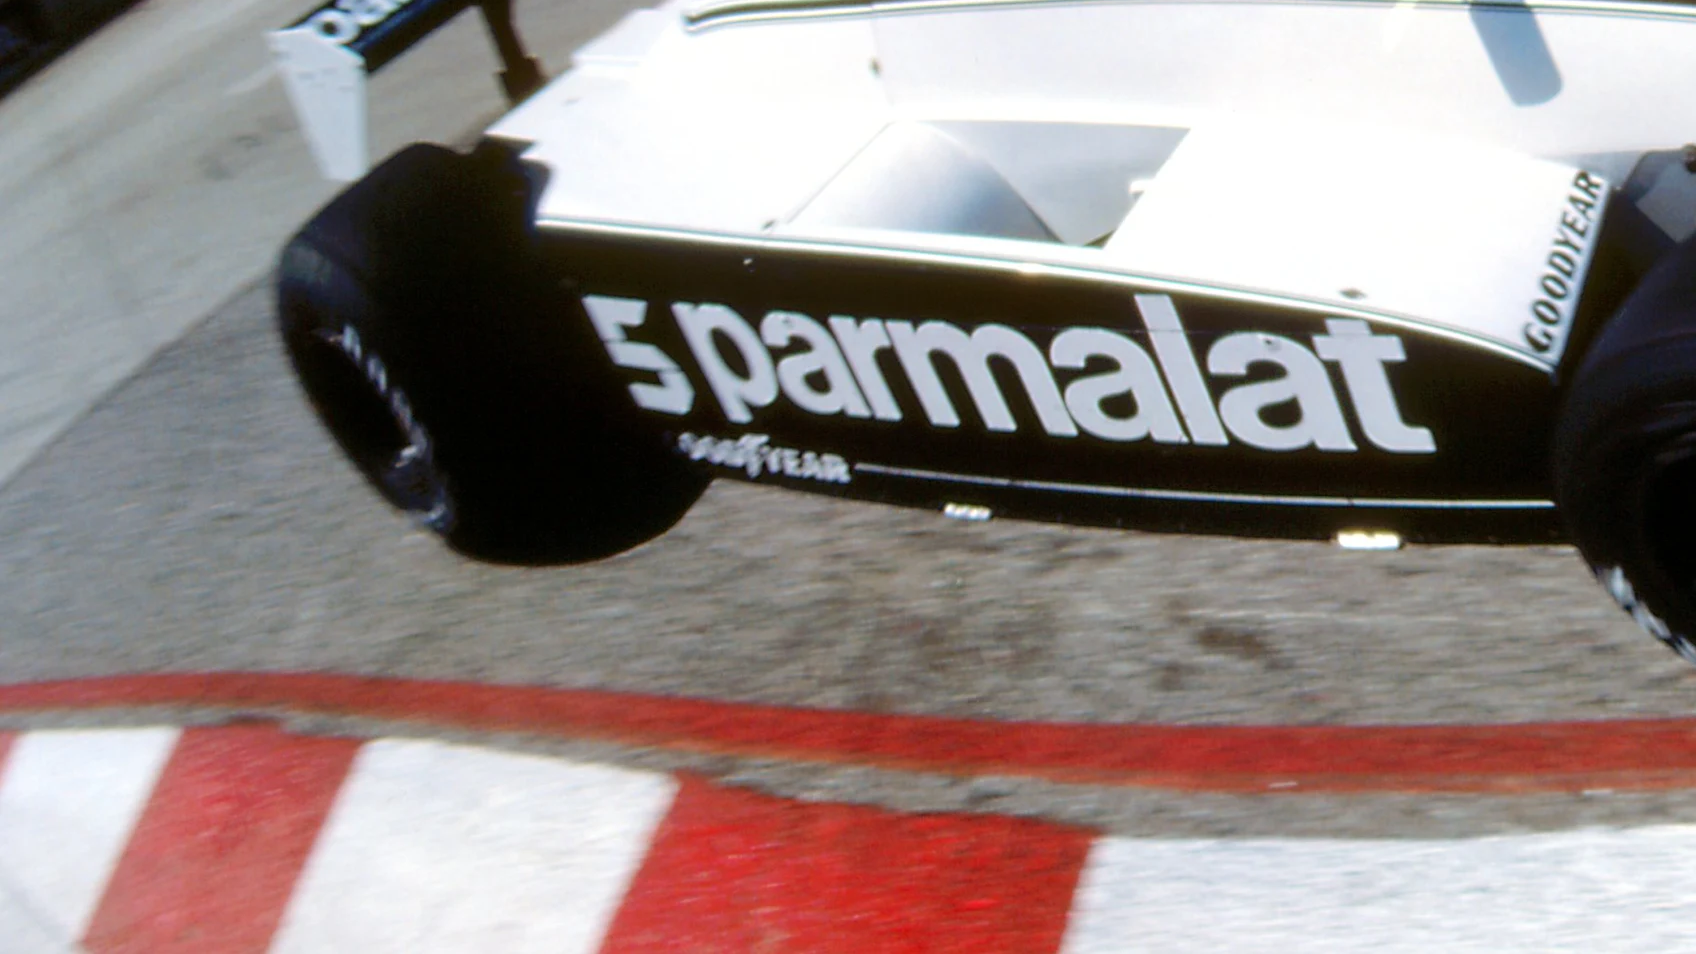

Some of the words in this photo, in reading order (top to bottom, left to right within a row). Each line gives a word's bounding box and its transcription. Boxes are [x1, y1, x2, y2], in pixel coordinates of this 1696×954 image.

[1522, 169, 1603, 354] GOODYEAR
[581, 294, 695, 416] 5
[670, 293, 1438, 453] parmalat
